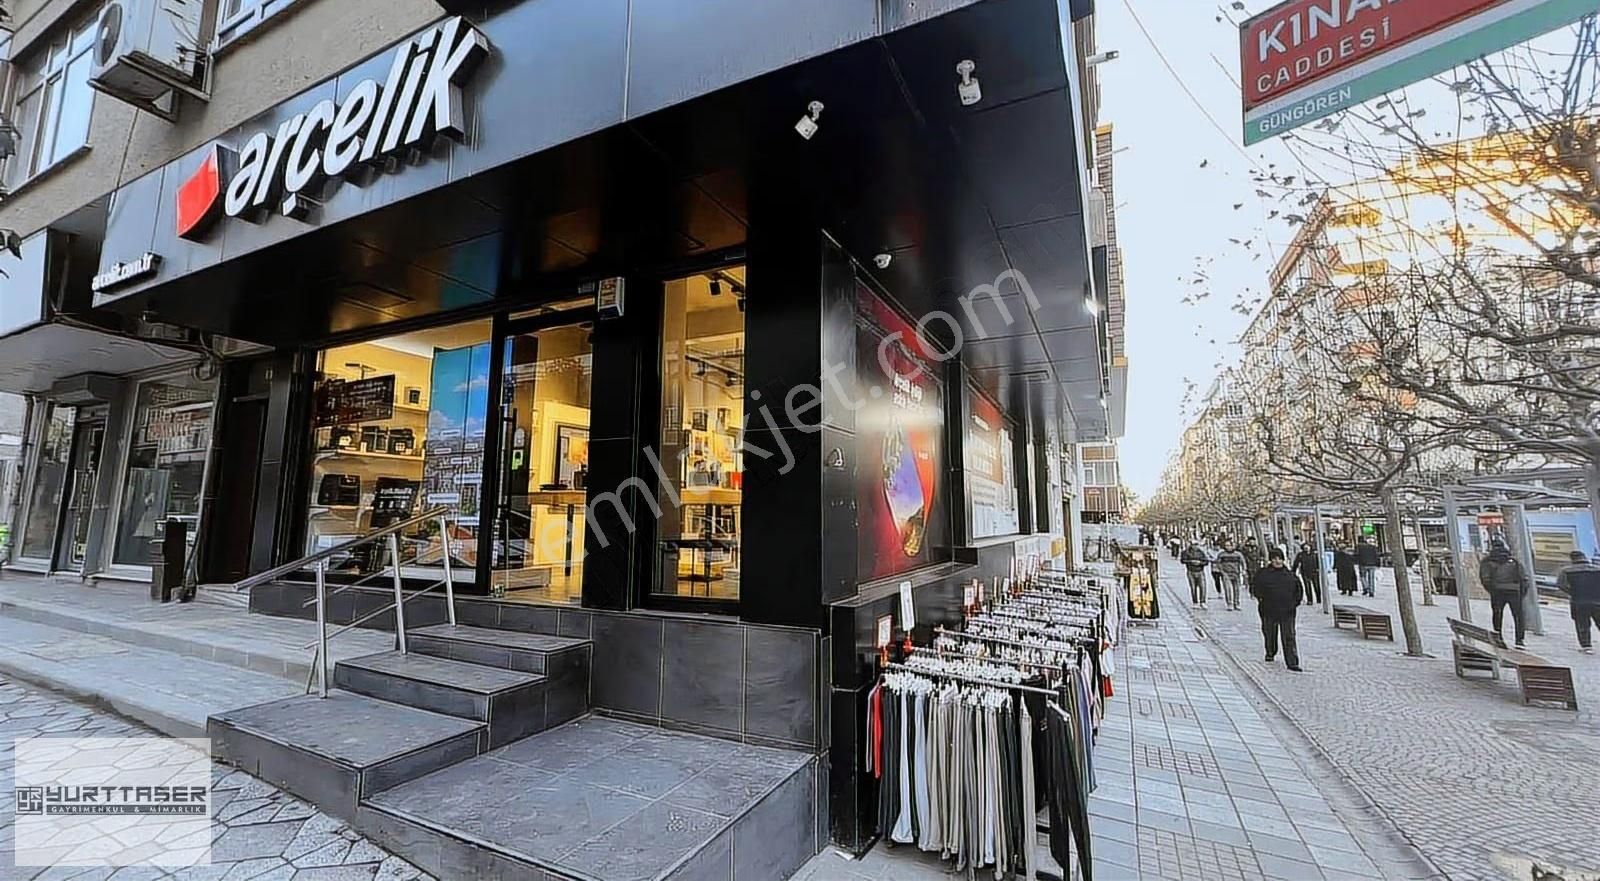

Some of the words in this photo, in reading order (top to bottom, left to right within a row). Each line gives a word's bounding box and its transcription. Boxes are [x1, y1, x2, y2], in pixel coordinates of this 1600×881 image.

[1257, 16, 1390, 93] CADDESİ
[1259, 0, 1403, 62] KINA
[225, 16, 475, 217] arçelik
[1259, 86, 1352, 132] GÜNGÖREN
